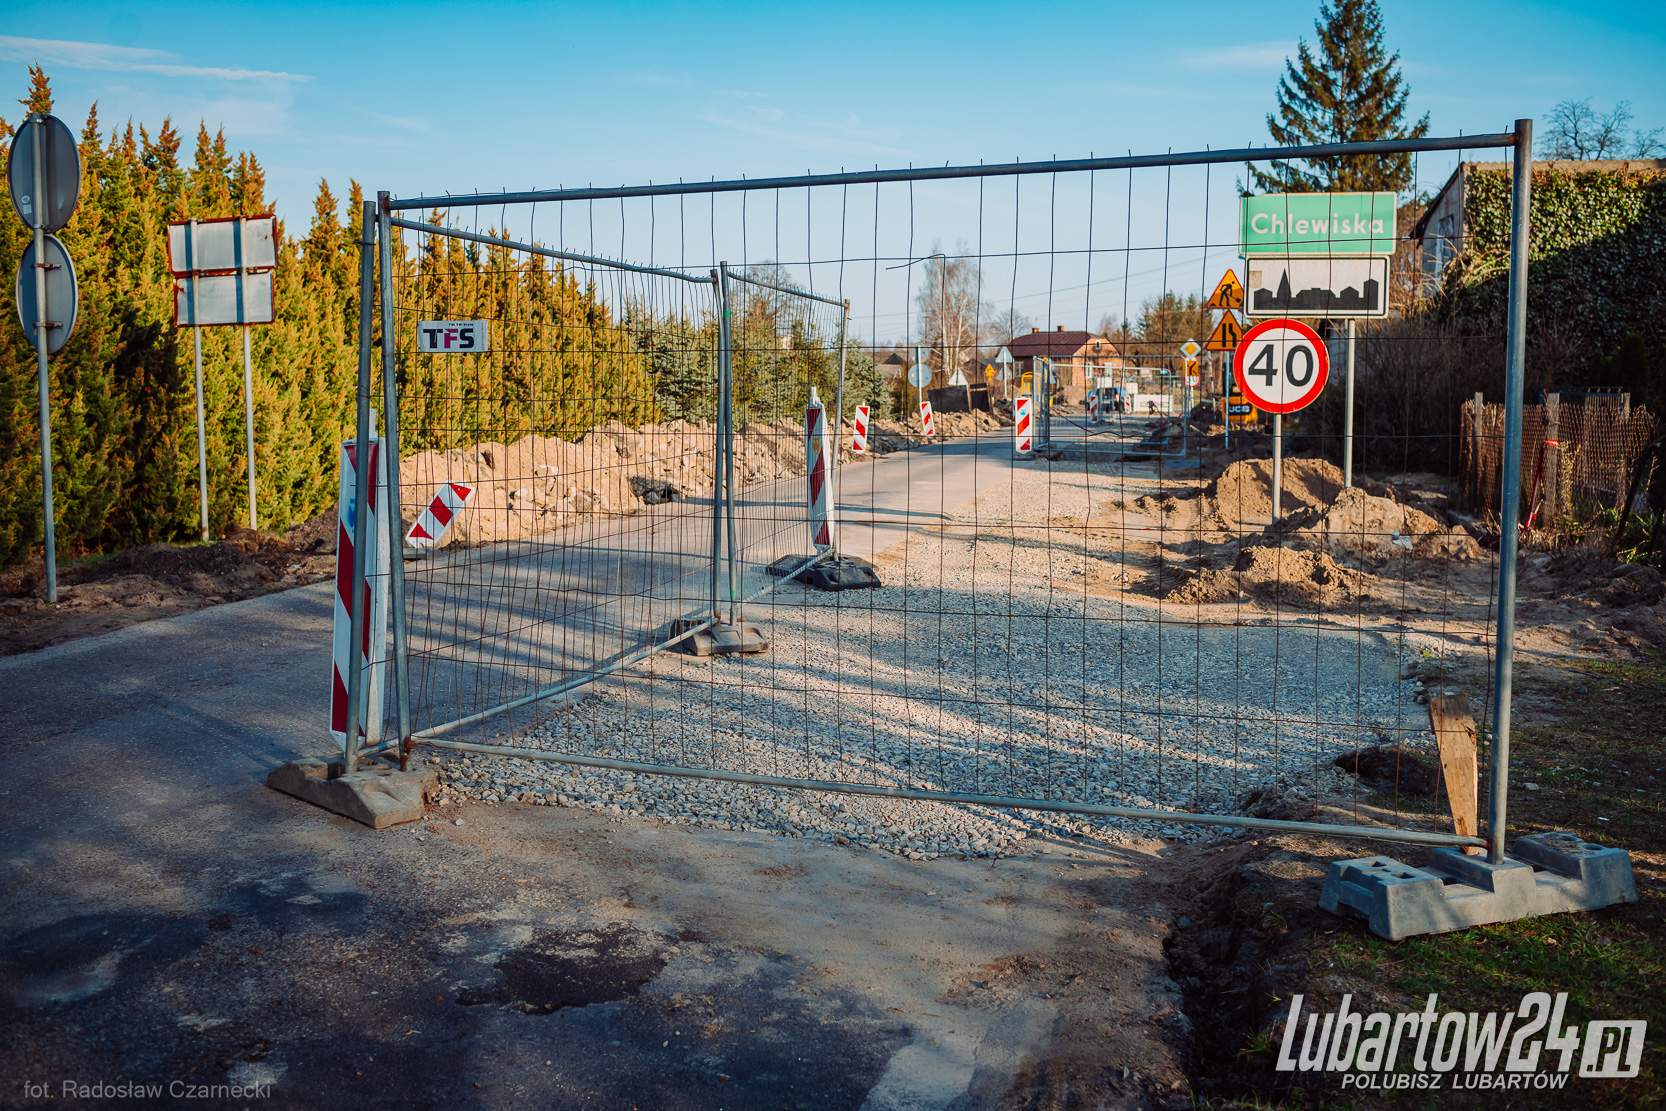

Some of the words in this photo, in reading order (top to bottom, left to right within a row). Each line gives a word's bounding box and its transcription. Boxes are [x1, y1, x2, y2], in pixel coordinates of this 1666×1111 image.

[1251, 212, 1384, 235] Chlewiska
[423, 328, 475, 349] TFS
[1248, 344, 1314, 387] 40
[1228, 405, 1250, 413] JCB
